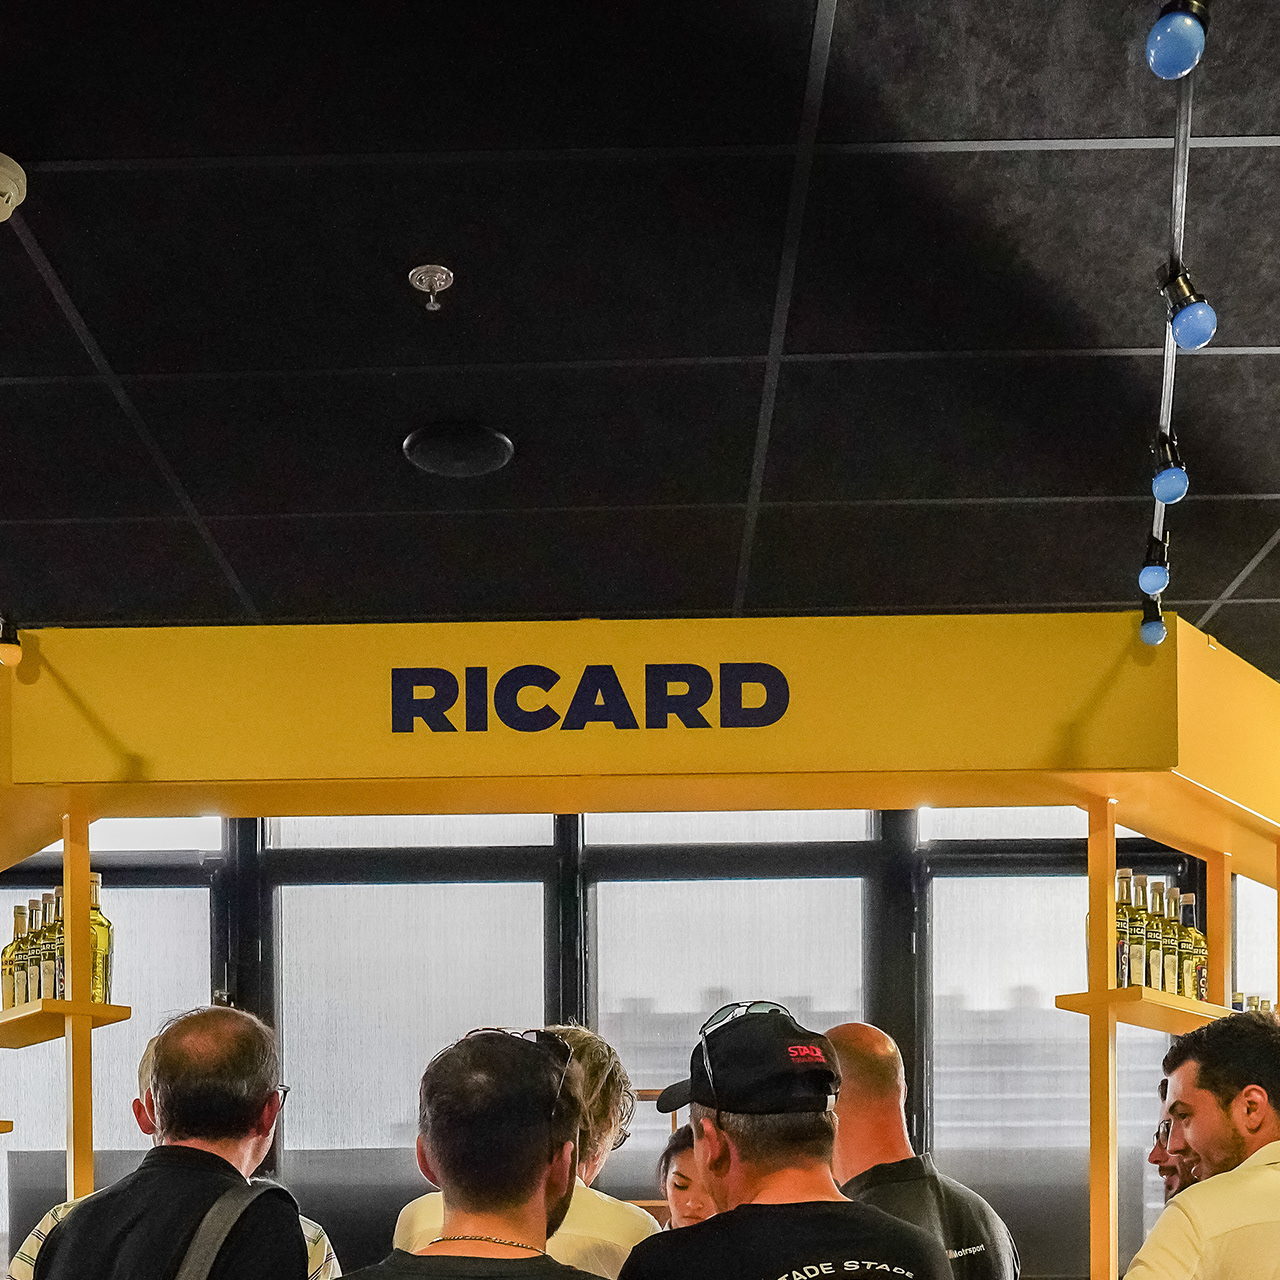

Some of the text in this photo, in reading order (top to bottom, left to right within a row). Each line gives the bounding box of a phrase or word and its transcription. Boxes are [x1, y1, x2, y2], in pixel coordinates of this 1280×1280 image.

[391, 662, 790, 733] RICARD
[788, 1045, 823, 1057] STADE
[843, 1260, 915, 1279] STADE
